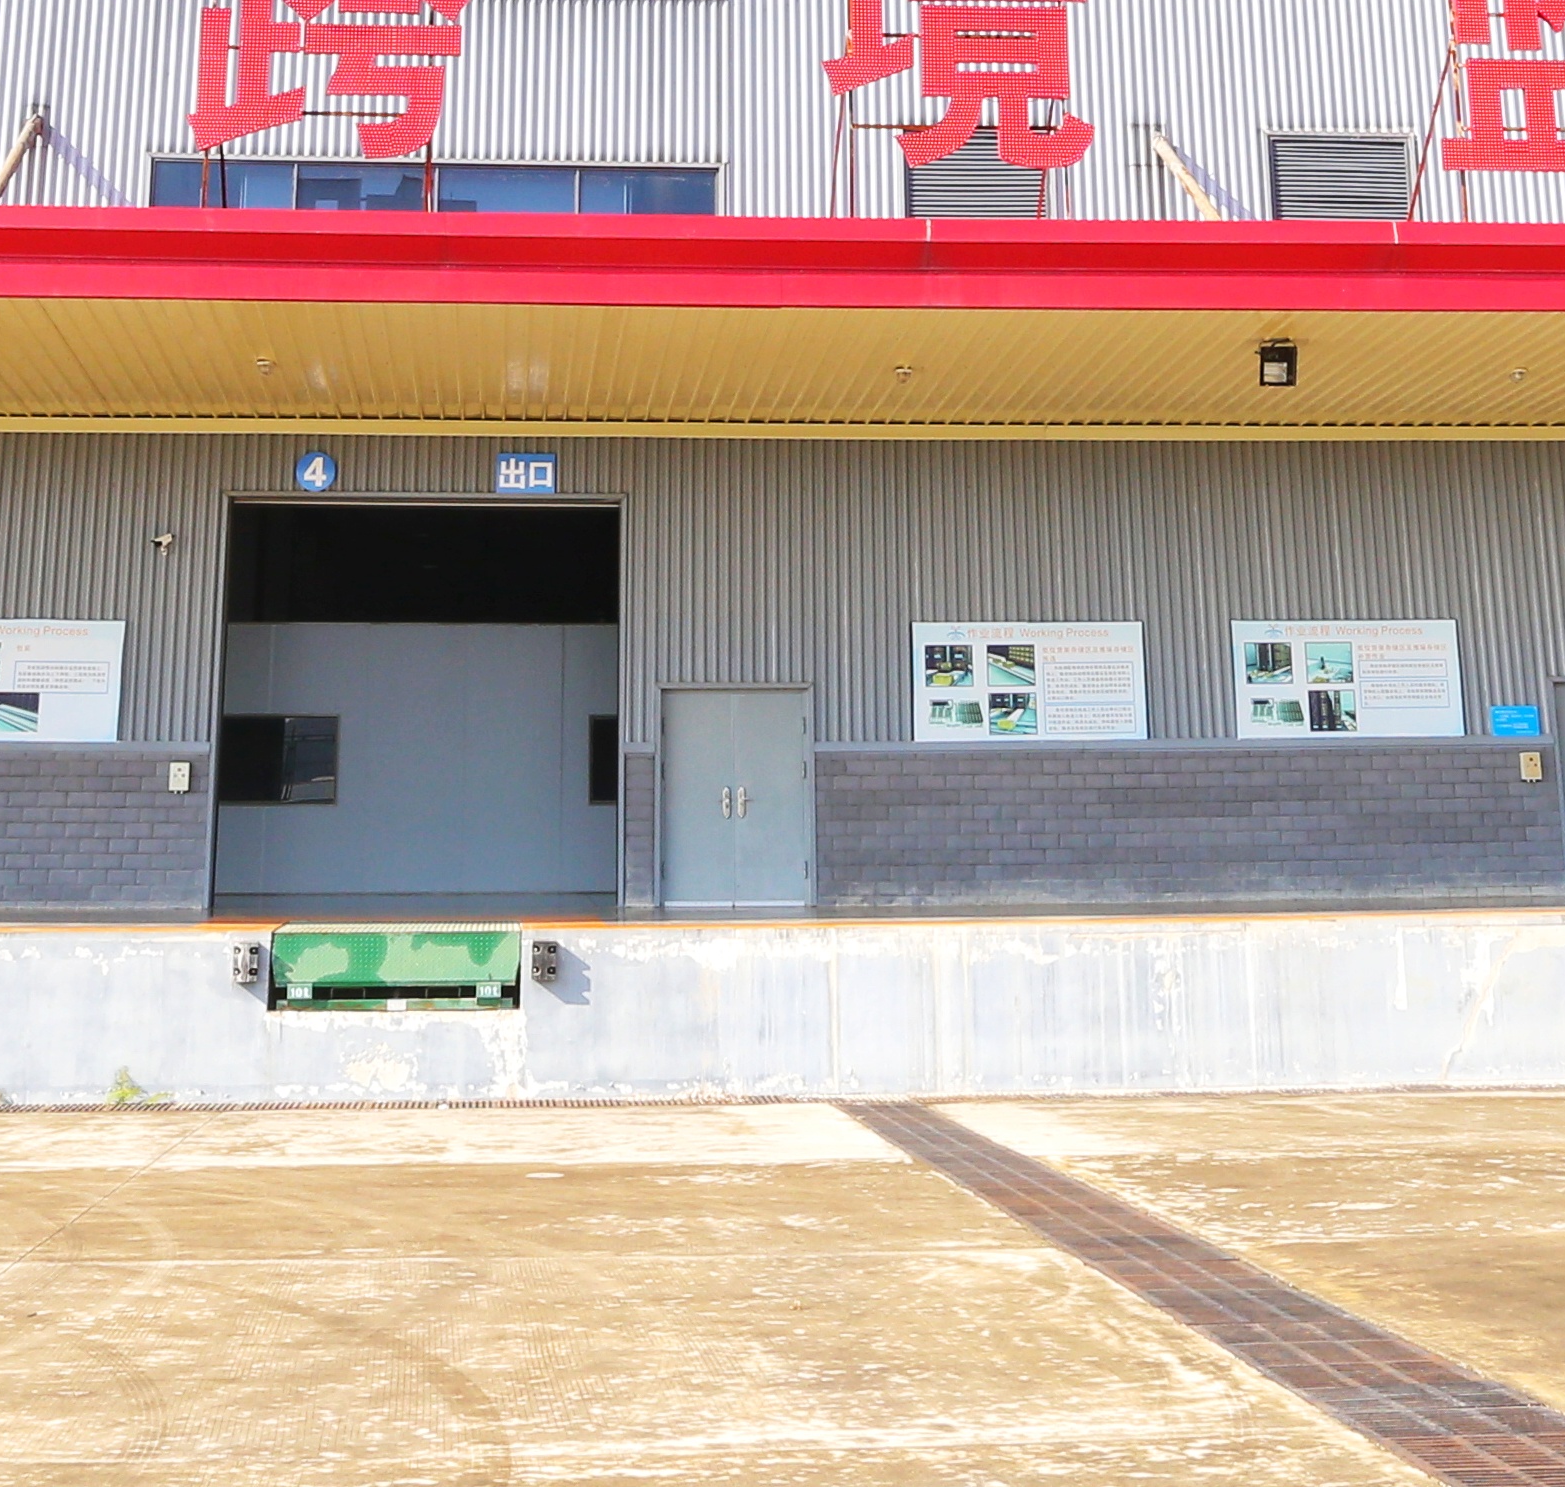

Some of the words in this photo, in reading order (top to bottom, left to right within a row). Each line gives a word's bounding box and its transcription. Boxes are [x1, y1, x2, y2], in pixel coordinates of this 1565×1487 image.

[303, 456, 328, 488] 4
[498, 457, 554, 490] 出口
[43, 625, 89, 636] Process
[967, 627, 1015, 639] 作业流程
[1020, 628, 1064, 640] Working
[1066, 628, 1109, 638] Process
[1285, 625, 1330, 637] 作业流程
[1336, 626, 1379, 638] Working
[1381, 626, 1423, 636] Process
